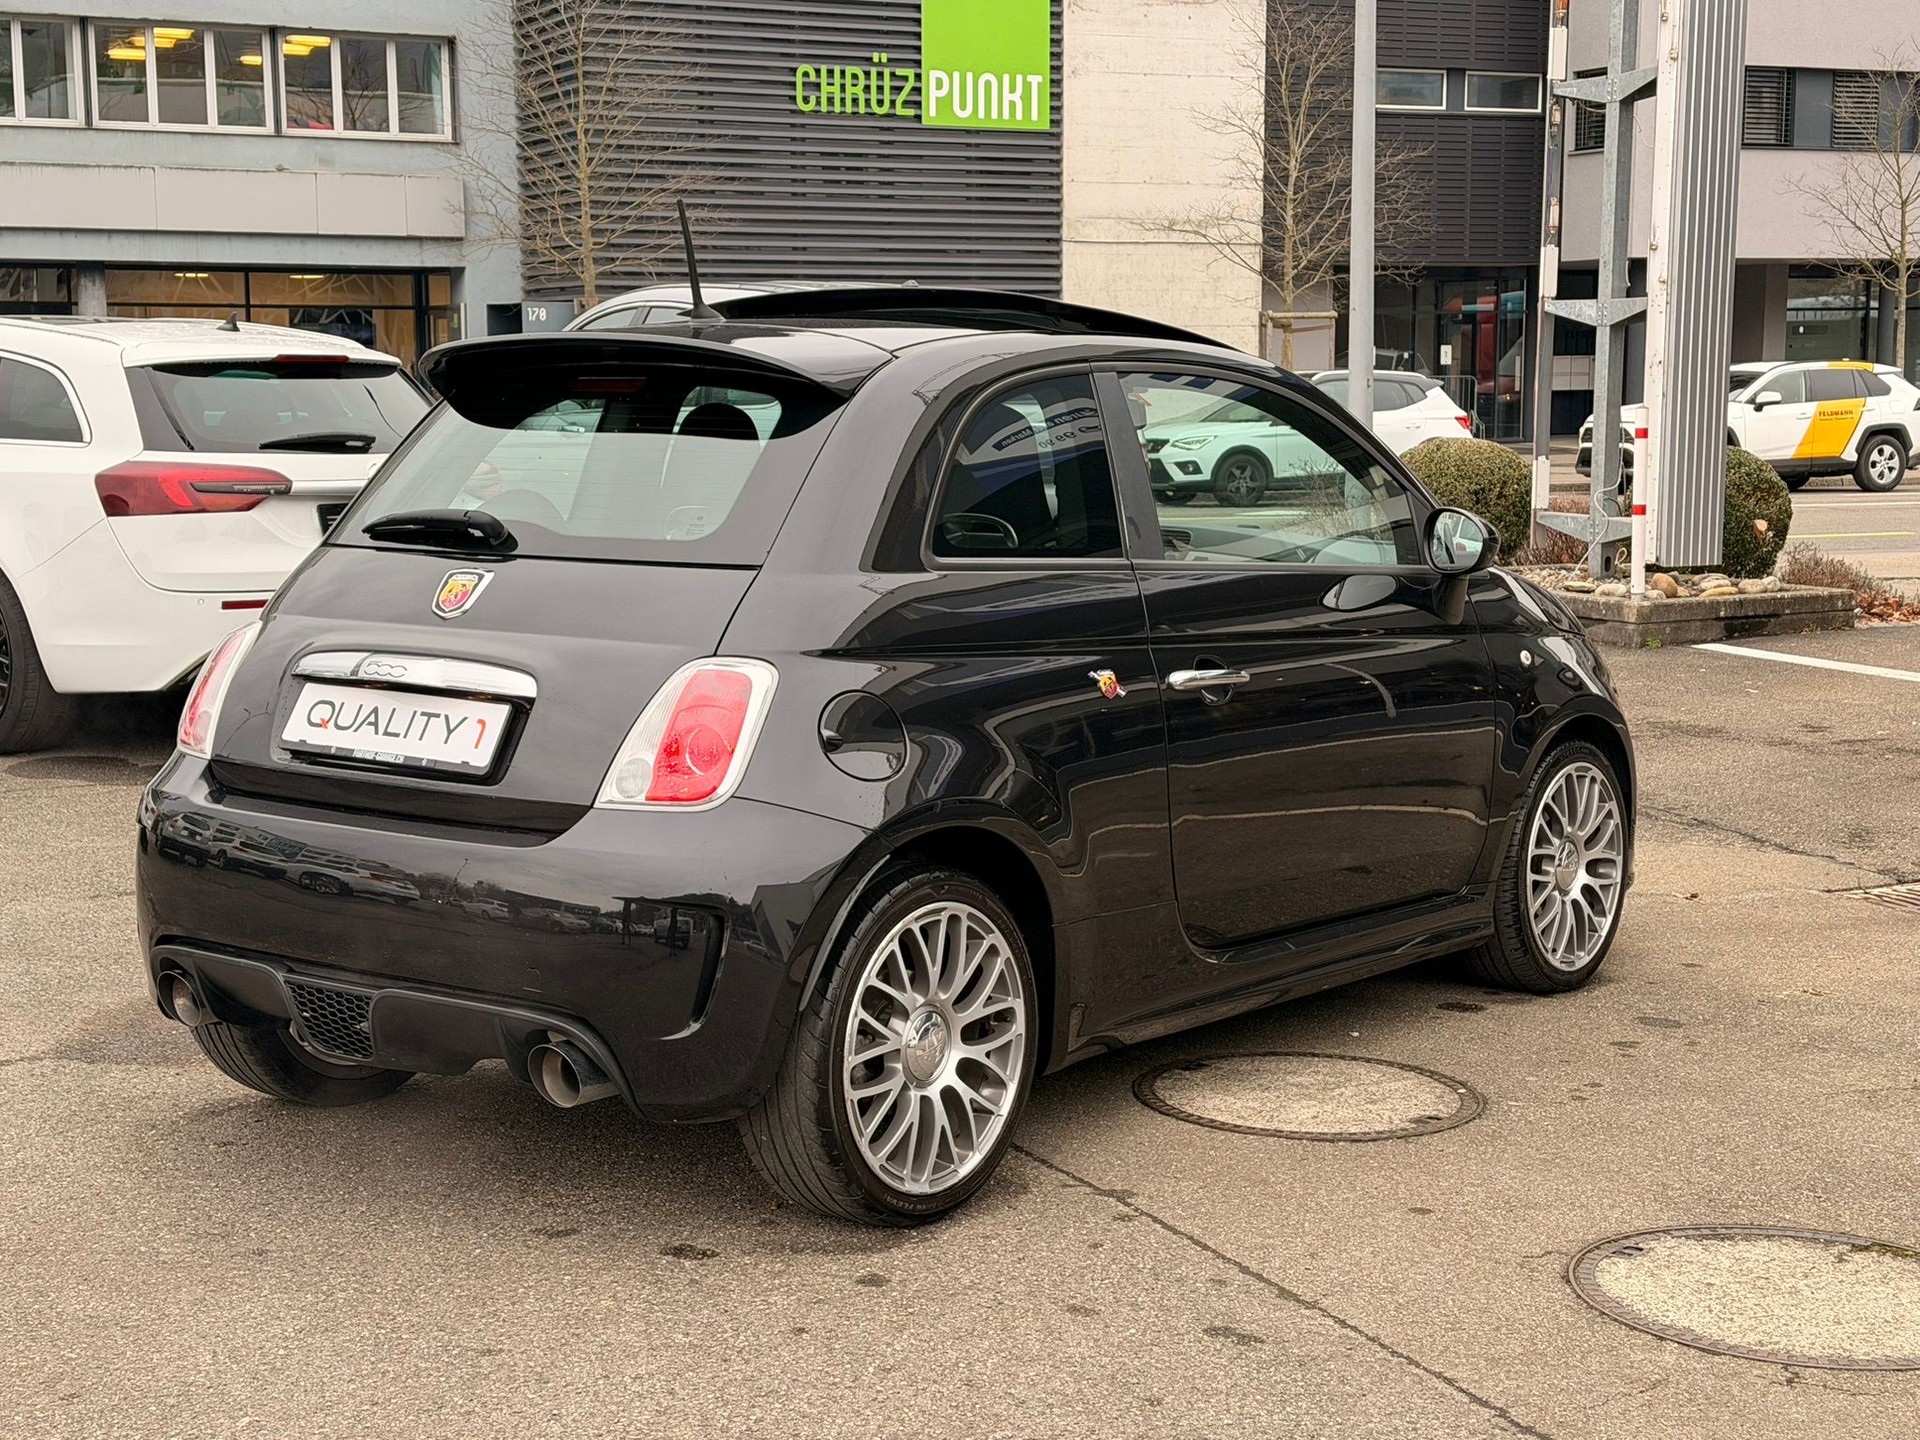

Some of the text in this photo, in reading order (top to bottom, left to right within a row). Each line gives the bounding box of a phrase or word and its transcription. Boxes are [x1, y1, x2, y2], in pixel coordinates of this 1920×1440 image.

[796, 52, 1043, 121] CHRÜZ PUNKT
[306, 700, 487, 749] QUALITY 1
